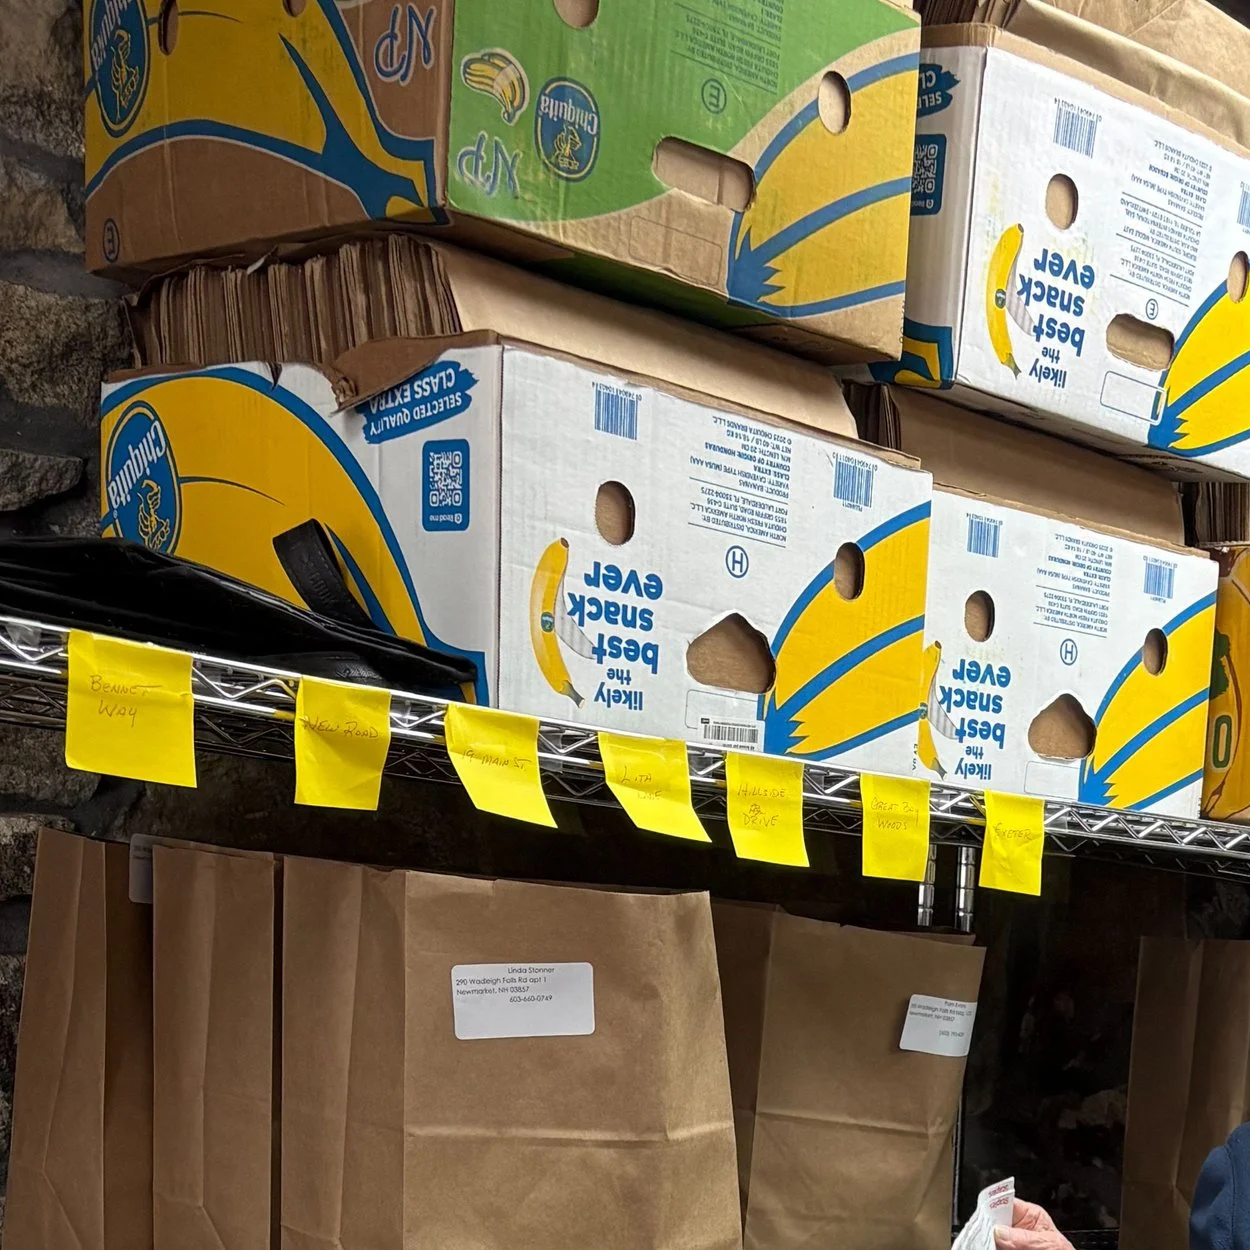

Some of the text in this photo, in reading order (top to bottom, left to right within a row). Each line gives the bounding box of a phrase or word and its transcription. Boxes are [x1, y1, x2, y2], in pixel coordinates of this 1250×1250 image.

[540, 95, 598, 135] Chiquita
[1033, 248, 1095, 289] ever
[1016, 274, 1084, 318] snack
[1032, 314, 1085, 357] best
[1042, 347, 1060, 364] the
[369, 368, 455, 414] CLASS EXTRA
[1029, 358, 1066, 389] likely
[370, 391, 462, 435] SELECTED QUALITY
[108, 420, 166, 510] Chiquita
[584, 561, 663, 601] ever
[567, 592, 654, 632] snack
[592, 633, 659, 674] best
[952, 659, 1011, 688] ever
[594, 682, 643, 711] likely
[607, 668, 631, 685] the
[938, 686, 1003, 714] snack
[955, 717, 1006, 750] best
[965, 746, 984, 760] the
[954, 758, 992, 780] likely
